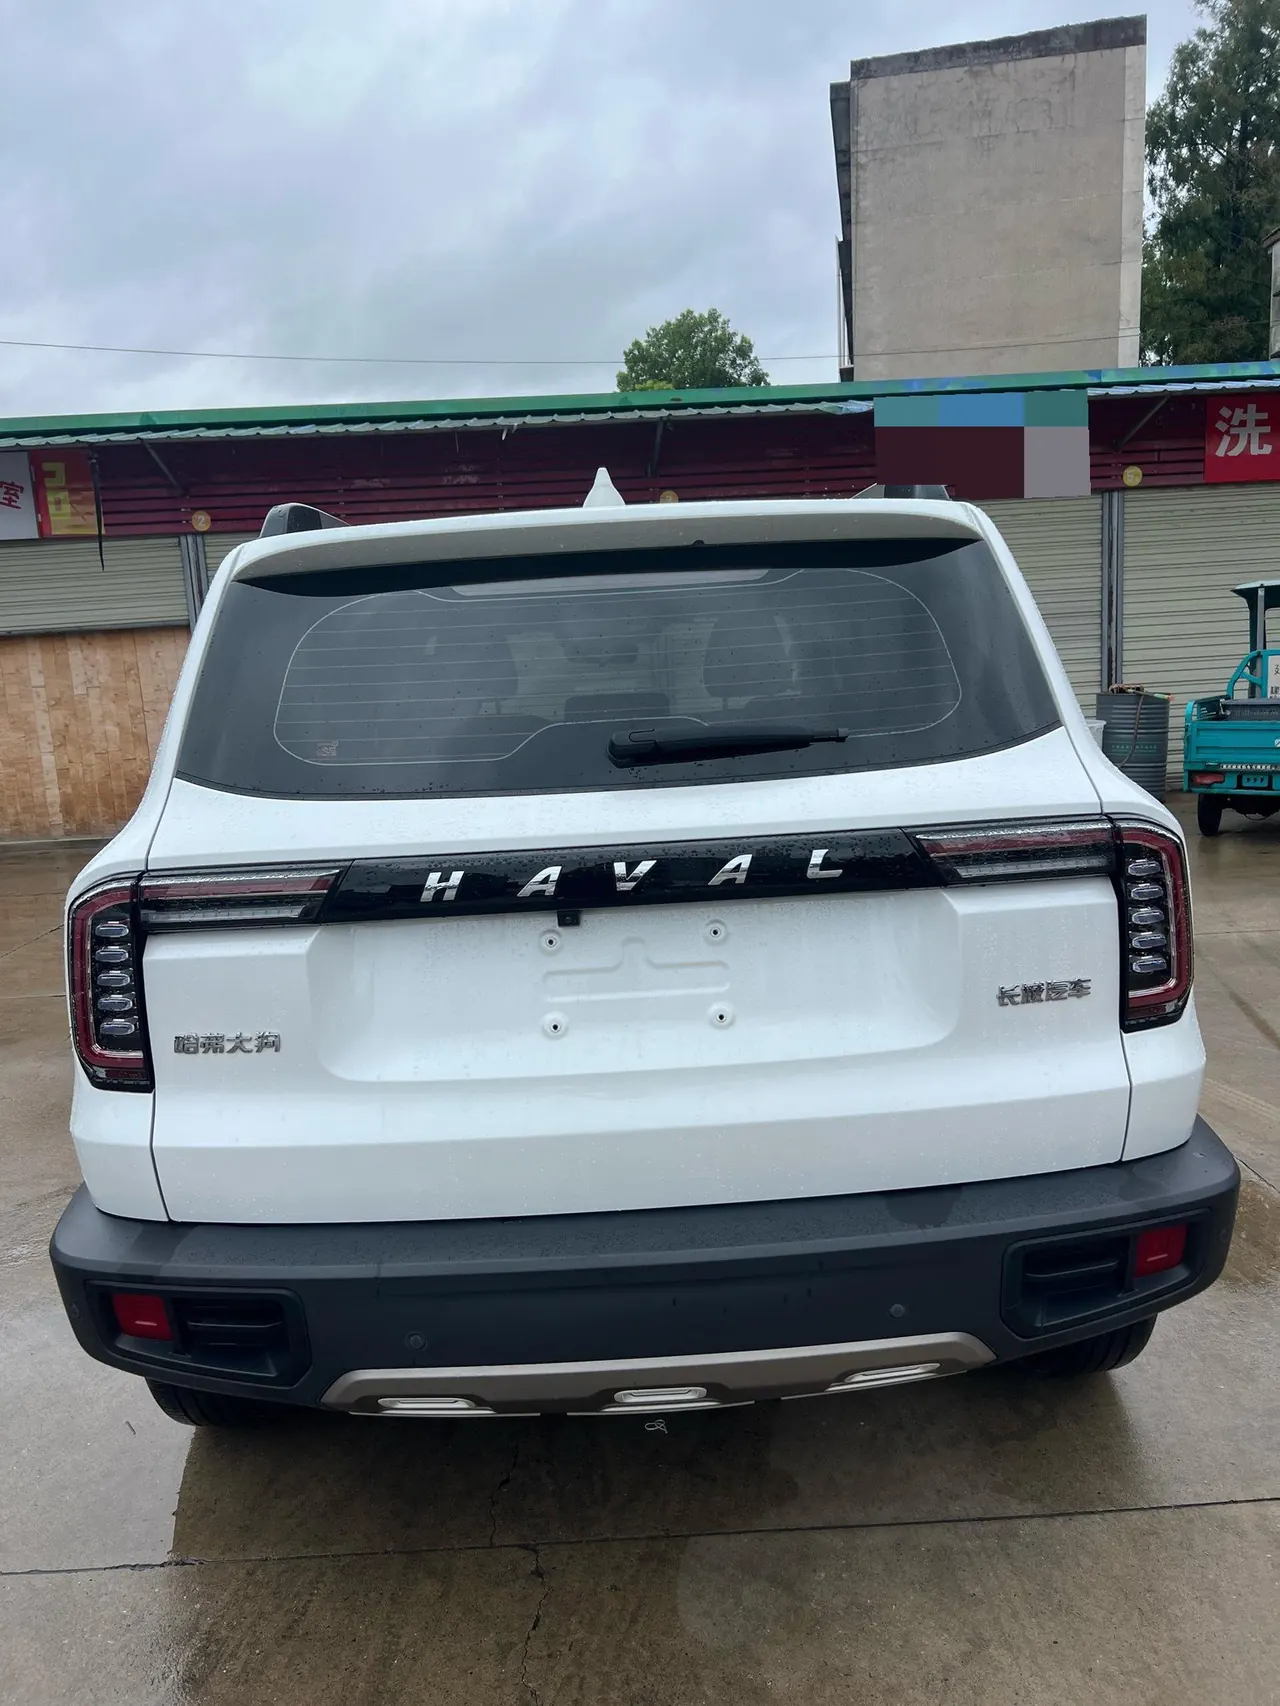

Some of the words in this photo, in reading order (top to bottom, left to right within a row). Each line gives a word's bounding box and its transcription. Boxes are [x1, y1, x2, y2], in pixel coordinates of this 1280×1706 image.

[1215, 404, 1272, 457] 洗
[0, 481, 24, 509] 室
[198, 515, 206, 526] 2
[420, 849, 842, 902] HAVAL
[997, 979, 1092, 1006] 长城汽车
[174, 1031, 281, 1054] 哈弗大狗
